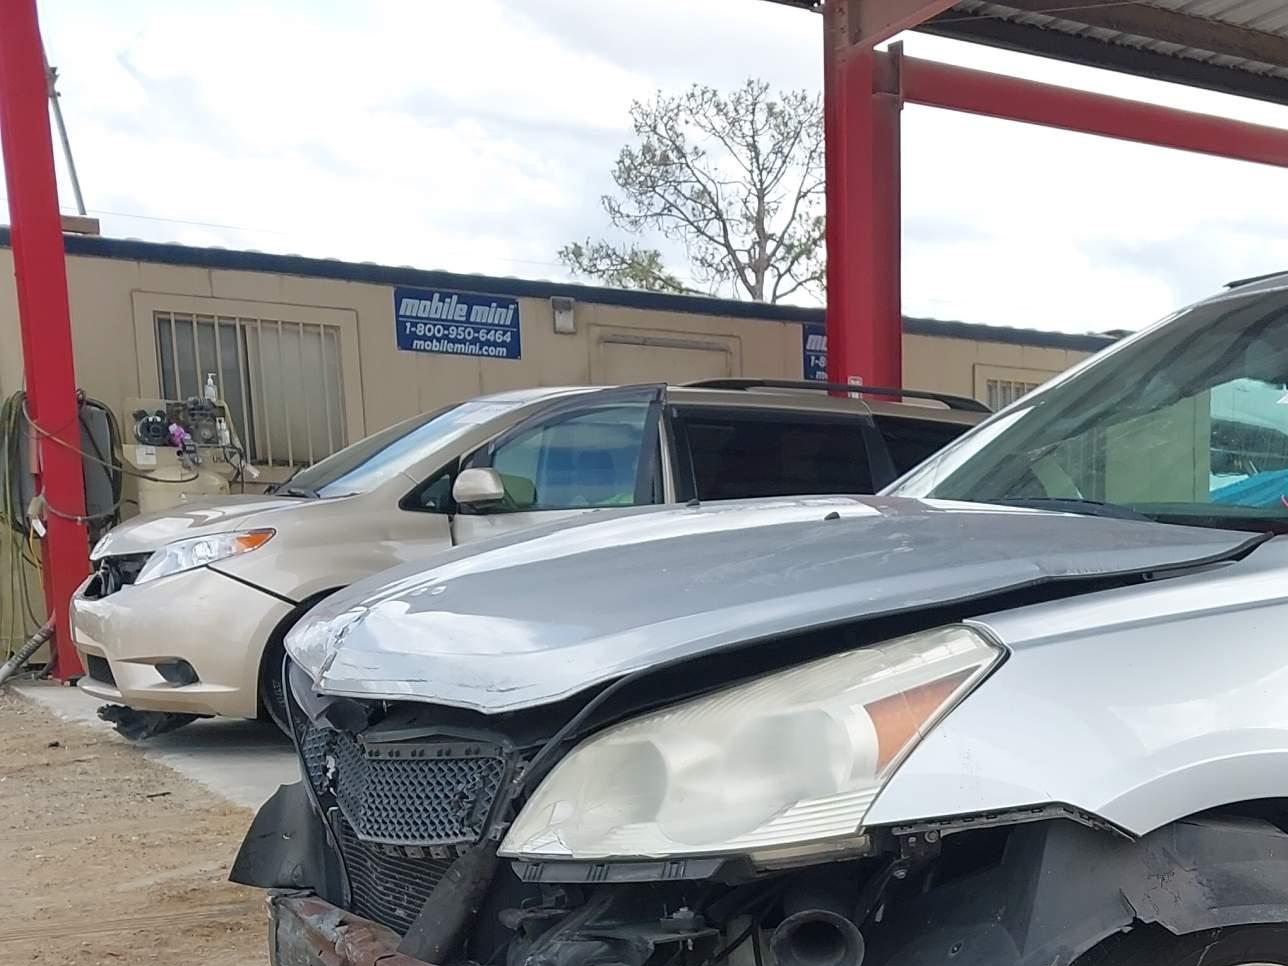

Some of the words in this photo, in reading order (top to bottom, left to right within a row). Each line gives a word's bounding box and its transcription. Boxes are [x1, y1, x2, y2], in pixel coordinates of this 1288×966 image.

[399, 293, 468, 321] mobile
[469, 302, 515, 325] mini
[405, 322, 512, 343] 1-800-950-6464
[413, 339, 508, 357] mobilemini.com
